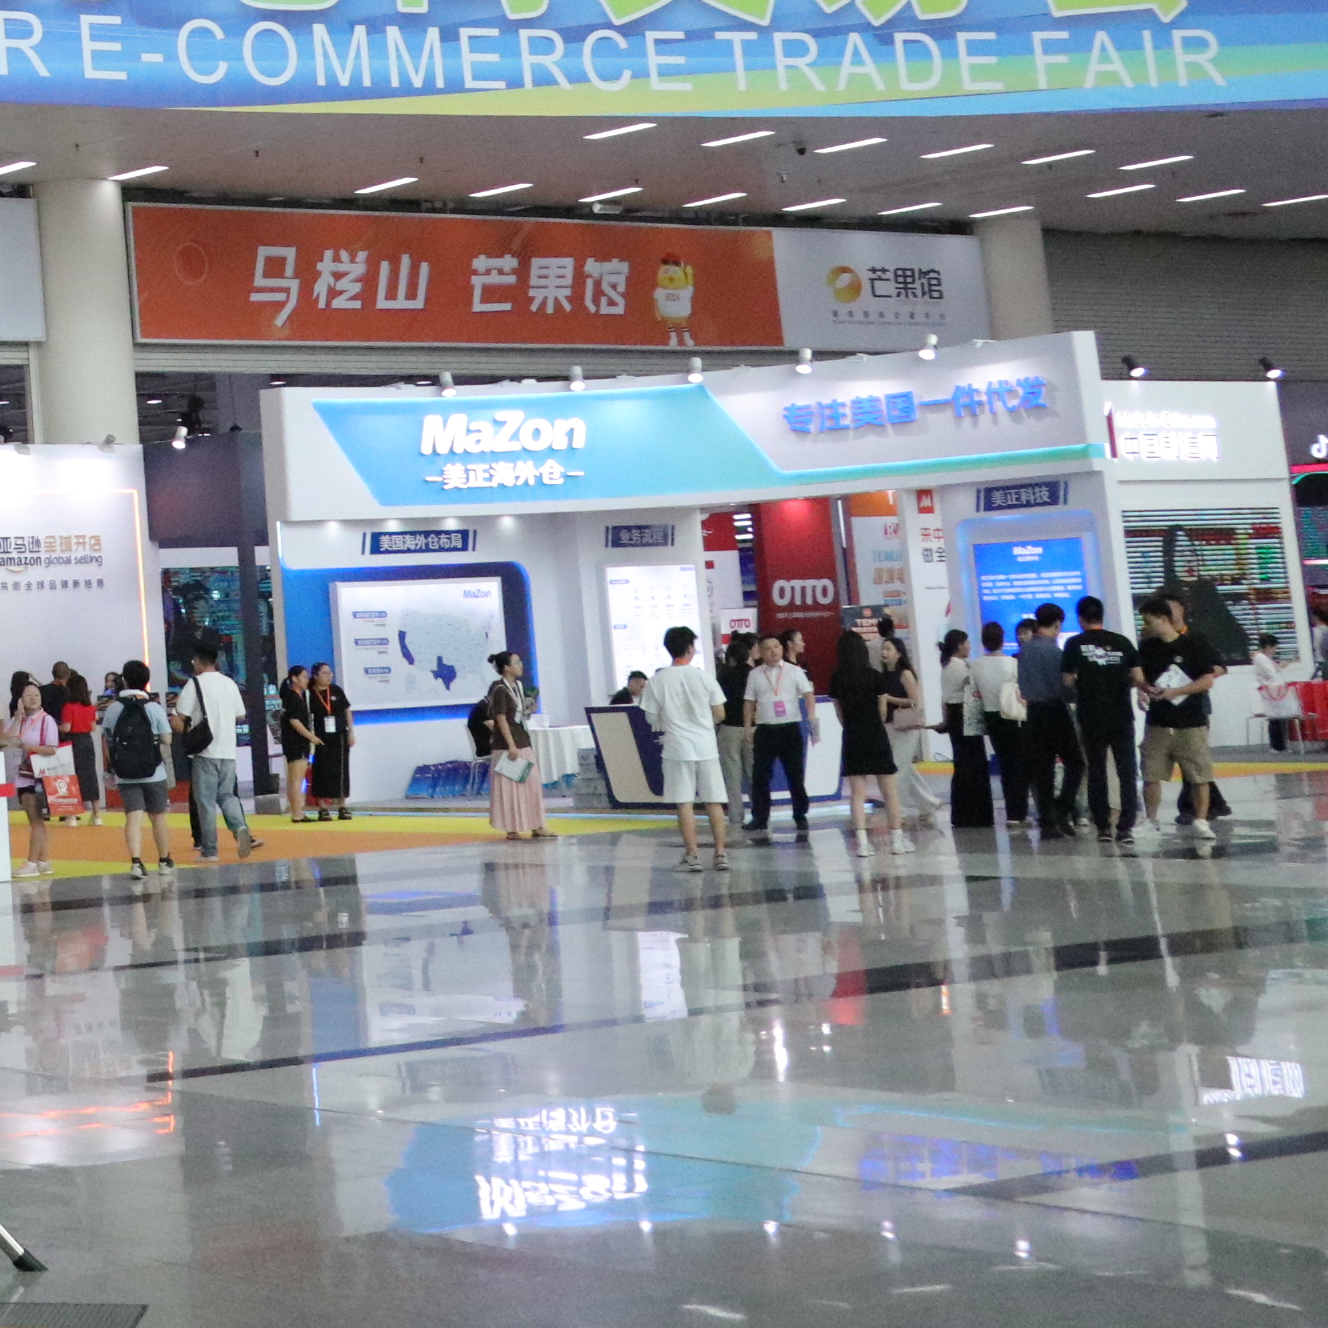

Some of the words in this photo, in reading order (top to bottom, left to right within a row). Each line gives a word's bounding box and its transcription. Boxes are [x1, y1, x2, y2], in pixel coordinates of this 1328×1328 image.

[81, 12, 694, 94] E-COMMERCE
[715, 27, 1004, 94] TRADE
[1036, 27, 1228, 90] FAIR
[249, 245, 430, 329] 马栏山
[470, 253, 630, 316] 芒果馆
[867, 266, 944, 301] 芒果馆
[782, 375, 1049, 435] 专注美国一件代发
[420, 409, 587, 456] MaZon
[990, 486, 1051, 507] 美正科技
[378, 533, 463, 552] 美国海外仓布局
[44, 554, 73, 568] global
[74, 554, 104, 567] selling
[462, 589, 492, 600] MaZon
[771, 578, 835, 607] OTTO
[730, 618, 751, 629] OTTO
